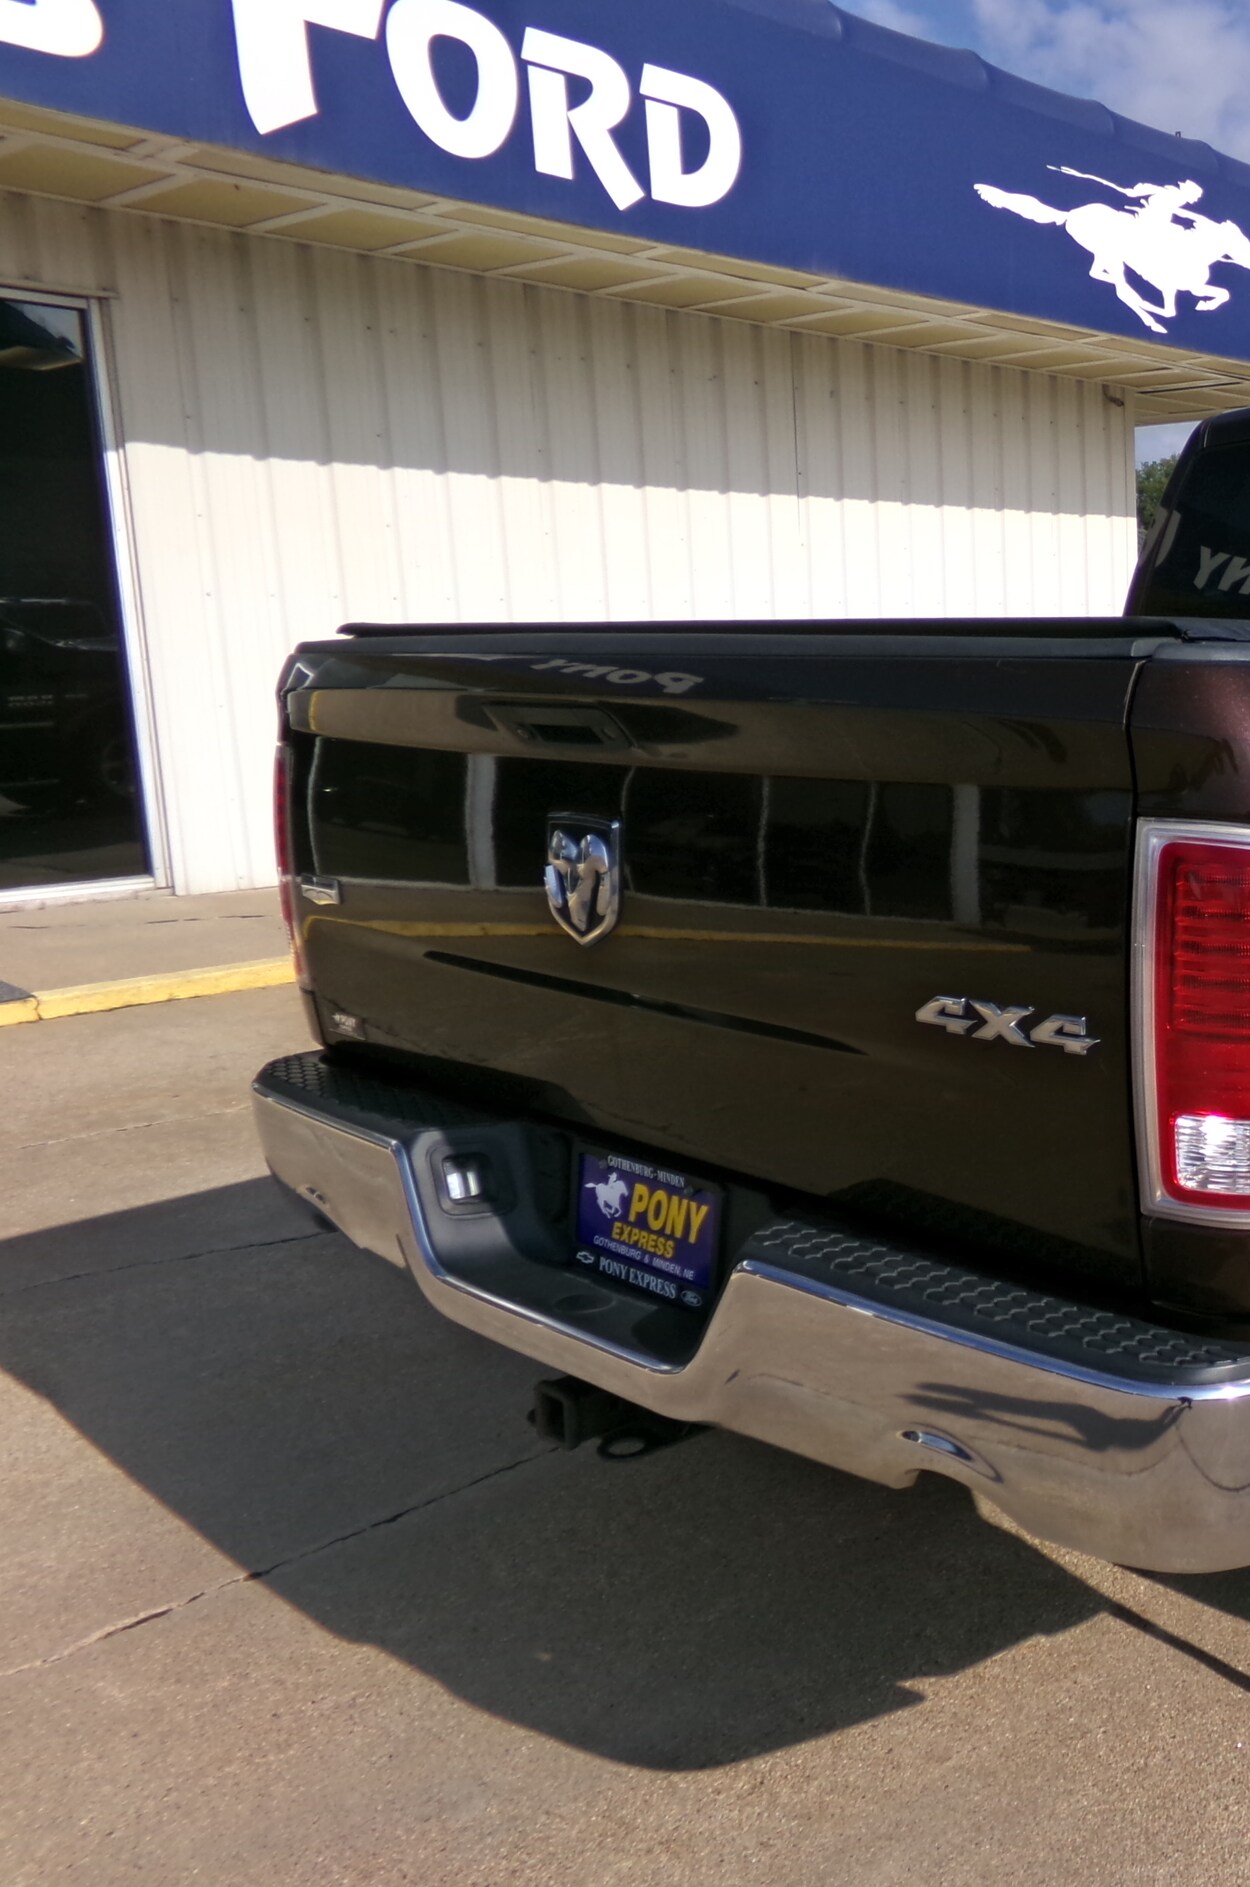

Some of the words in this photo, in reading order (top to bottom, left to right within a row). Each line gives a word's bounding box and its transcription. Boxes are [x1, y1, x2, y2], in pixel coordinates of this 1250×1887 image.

[232, 0, 742, 211] FORD
[628, 1182, 709, 1244] PONY
[593, 1235, 641, 1261] GOTHENBURG
[683, 1269, 695, 1281] NE
[611, 1221, 676, 1259] EXPRESS
[599, 1256, 628, 1280] PONY
[629, 1270, 677, 1299] EXPRESS
